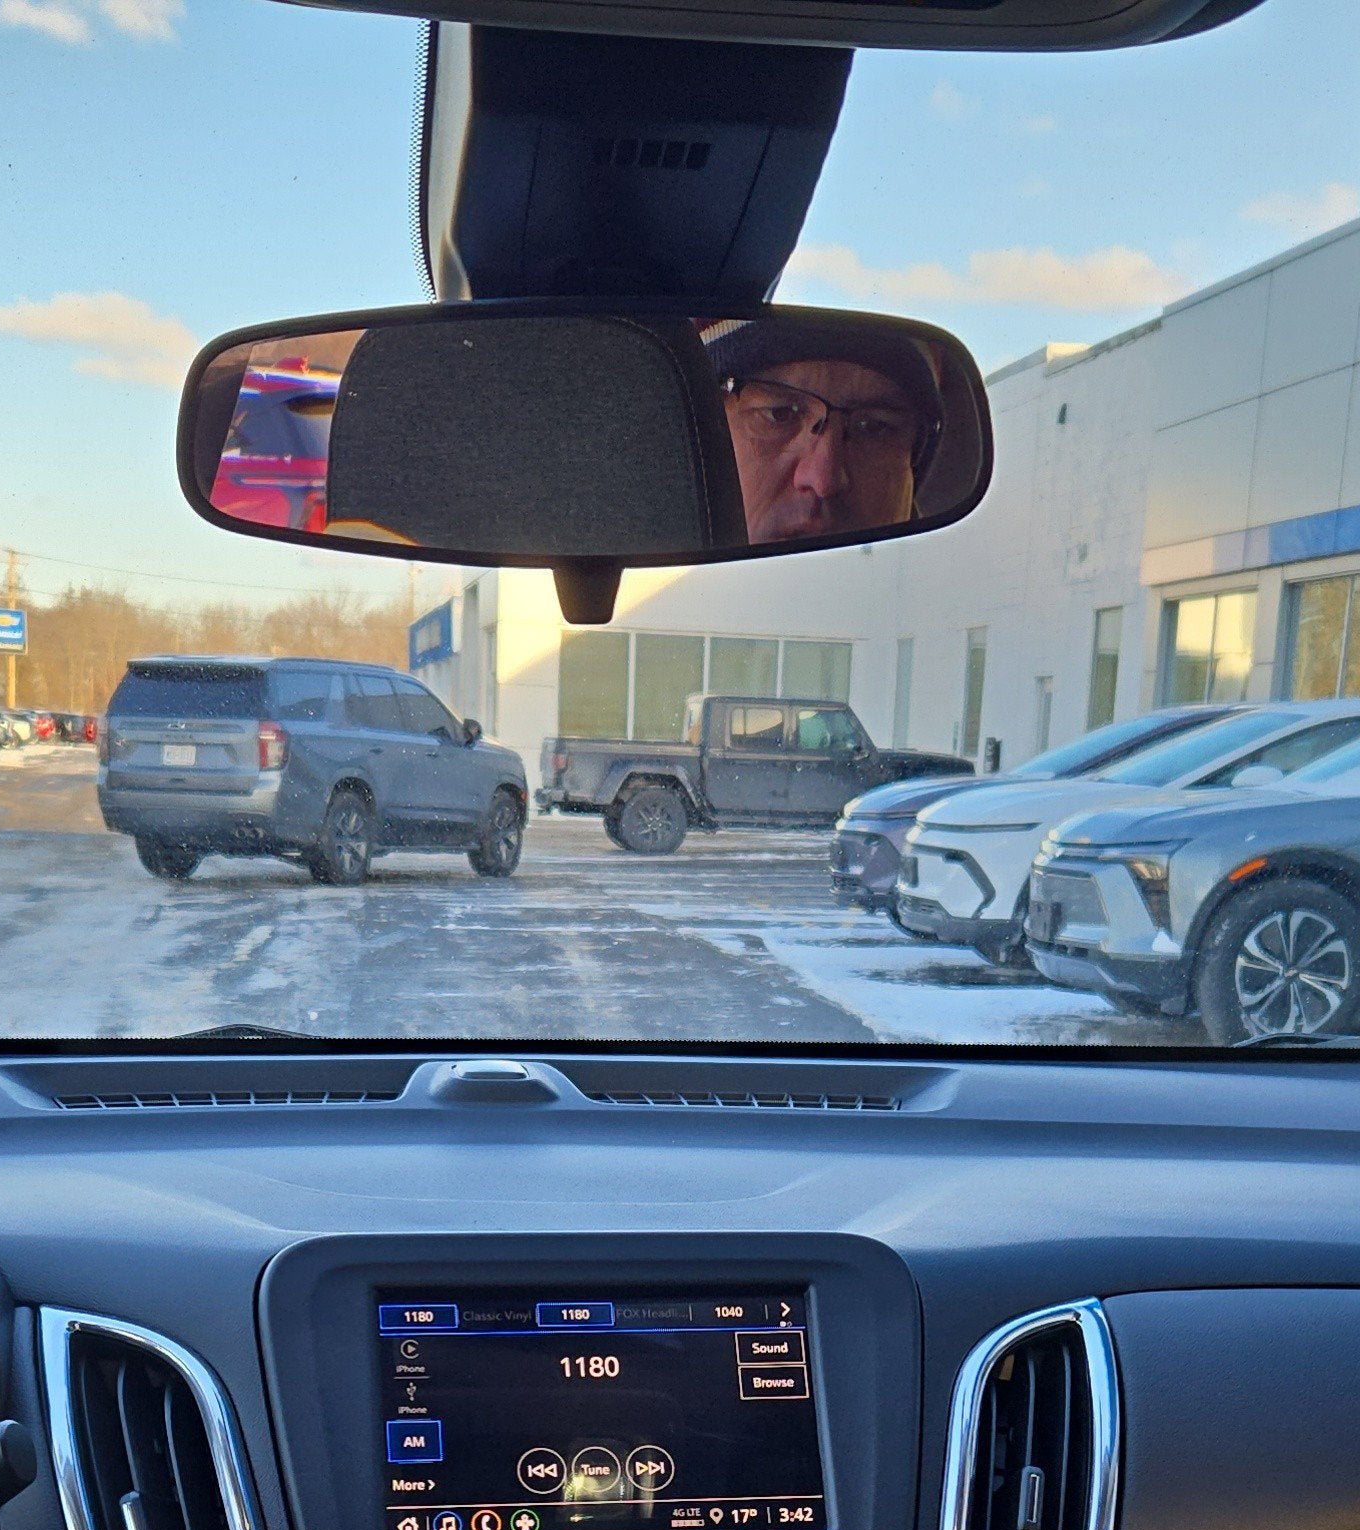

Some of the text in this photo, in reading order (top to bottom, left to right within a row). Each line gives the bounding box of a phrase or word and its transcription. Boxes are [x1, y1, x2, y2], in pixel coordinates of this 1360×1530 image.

[404, 1311, 434, 1322] 1180
[463, 1310, 532, 1322] Classic Vinyl
[561, 1309, 590, 1320] 1180
[715, 1307, 743, 1318] 1040
[751, 1342, 789, 1355] Sound
[396, 1365, 425, 1373] iPhone
[560, 1356, 620, 1378] 1180
[753, 1377, 794, 1389] Browse
[398, 1406, 428, 1414] iPhone
[403, 1436, 425, 1448] AM
[581, 1464, 610, 1475] Tune
[392, 1480, 425, 1491] More
[672, 1508, 701, 1517] 4G LTE
[779, 1507, 814, 1523] 3:42
